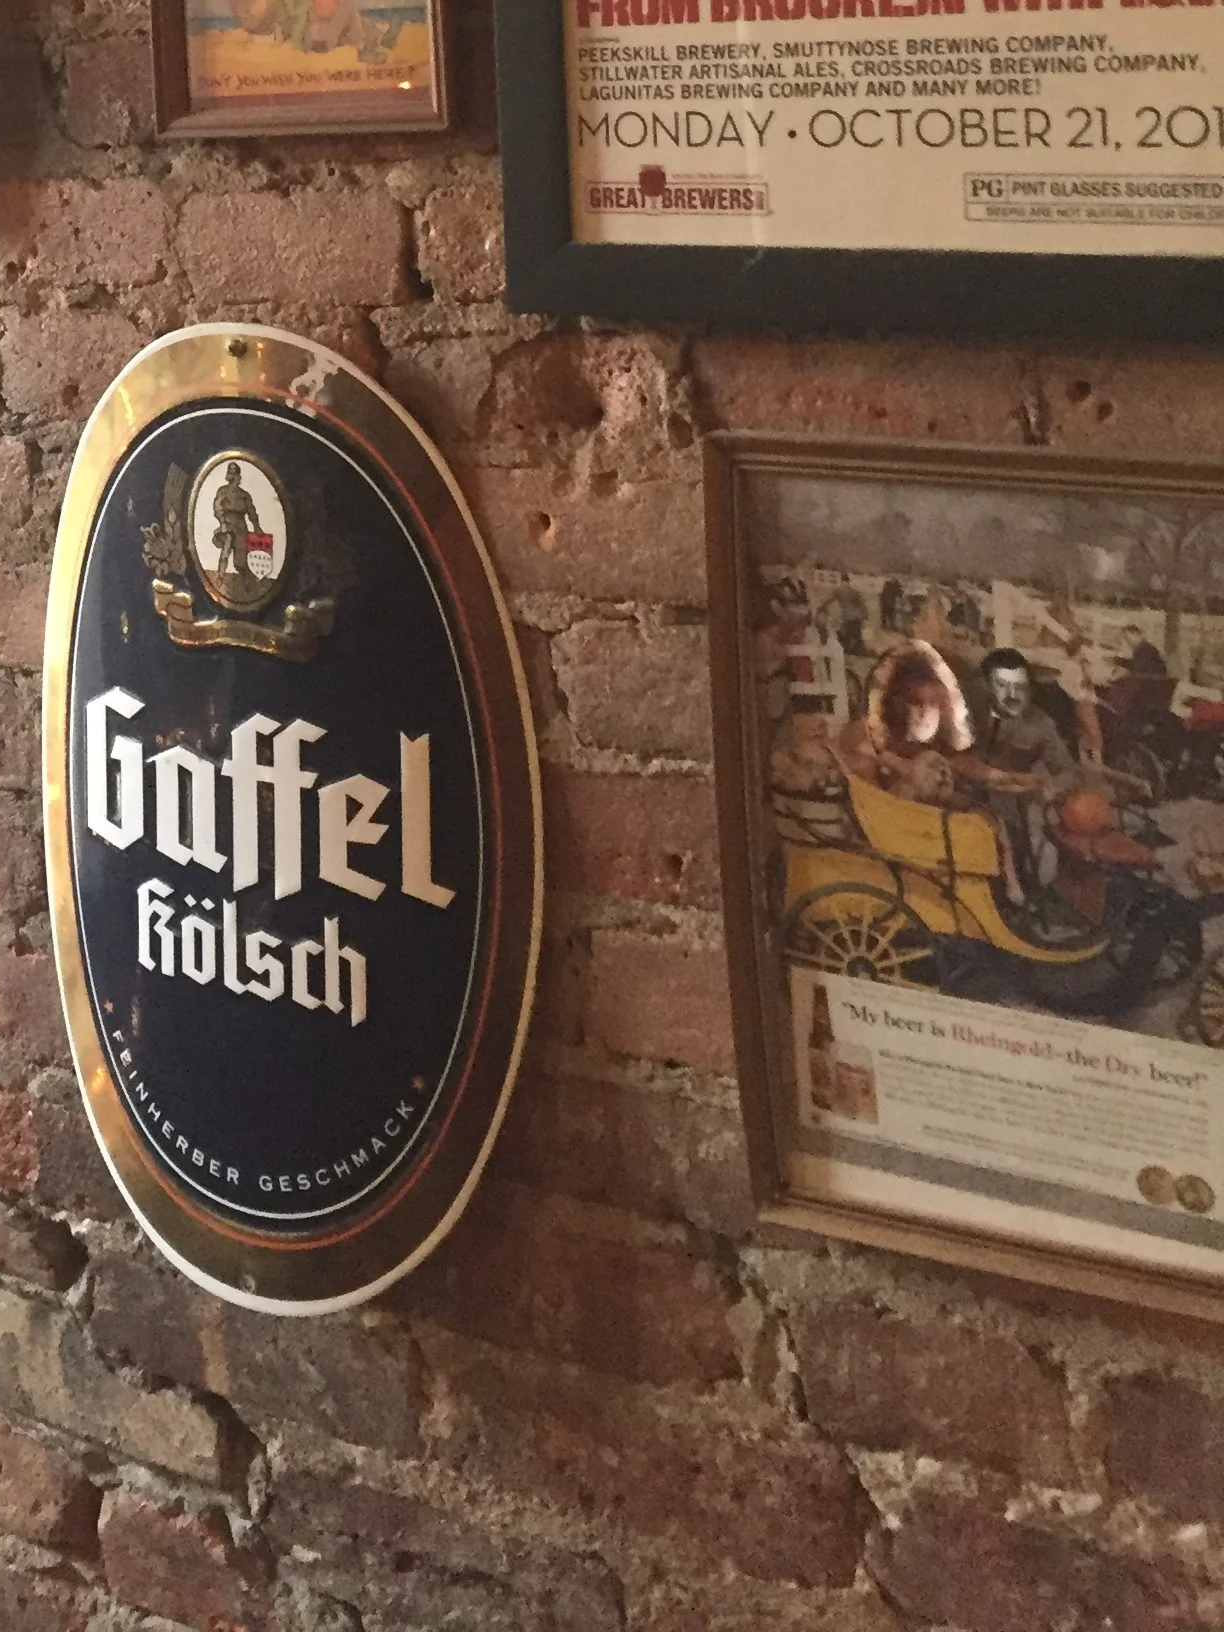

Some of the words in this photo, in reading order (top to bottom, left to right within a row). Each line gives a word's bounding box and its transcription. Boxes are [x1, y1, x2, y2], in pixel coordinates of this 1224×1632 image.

[578, 44, 670, 63] PEEKSKILL
[772, 36, 899, 58] SMUTTYNOSE
[906, 36, 999, 55] BREWING
[579, 63, 683, 82] STILLWATER
[688, 61, 787, 80] ARTISANAL
[851, 57, 983, 77] CROSSROADS
[989, 54, 1088, 74] BREWING
[579, 83, 675, 101] LAGUNITAS
[680, 82, 764, 100] BREWING
[768, 81, 860, 99] COMPANY
[865, 80, 906, 97] AND
[911, 78, 969, 97] MANY
[578, 109, 775, 149] MONDAY
[809, 106, 1052, 149] OCTOBER
[1066, 106, 1123, 151] 21,
[661, 186, 754, 211] BREWERS
[971, 178, 1004, 200] PG
[1012, 181, 1047, 198] PINT
[1050, 181, 1121, 199] GLASSES
[1125, 181, 1224, 200] SUGGESTED
[85, 686, 457, 911] Gaffel
[137, 877, 368, 1028] Kölsch
[111, 1030, 241, 1186] FEINHERBER
[258, 1099, 415, 1193] GESCHMACK
